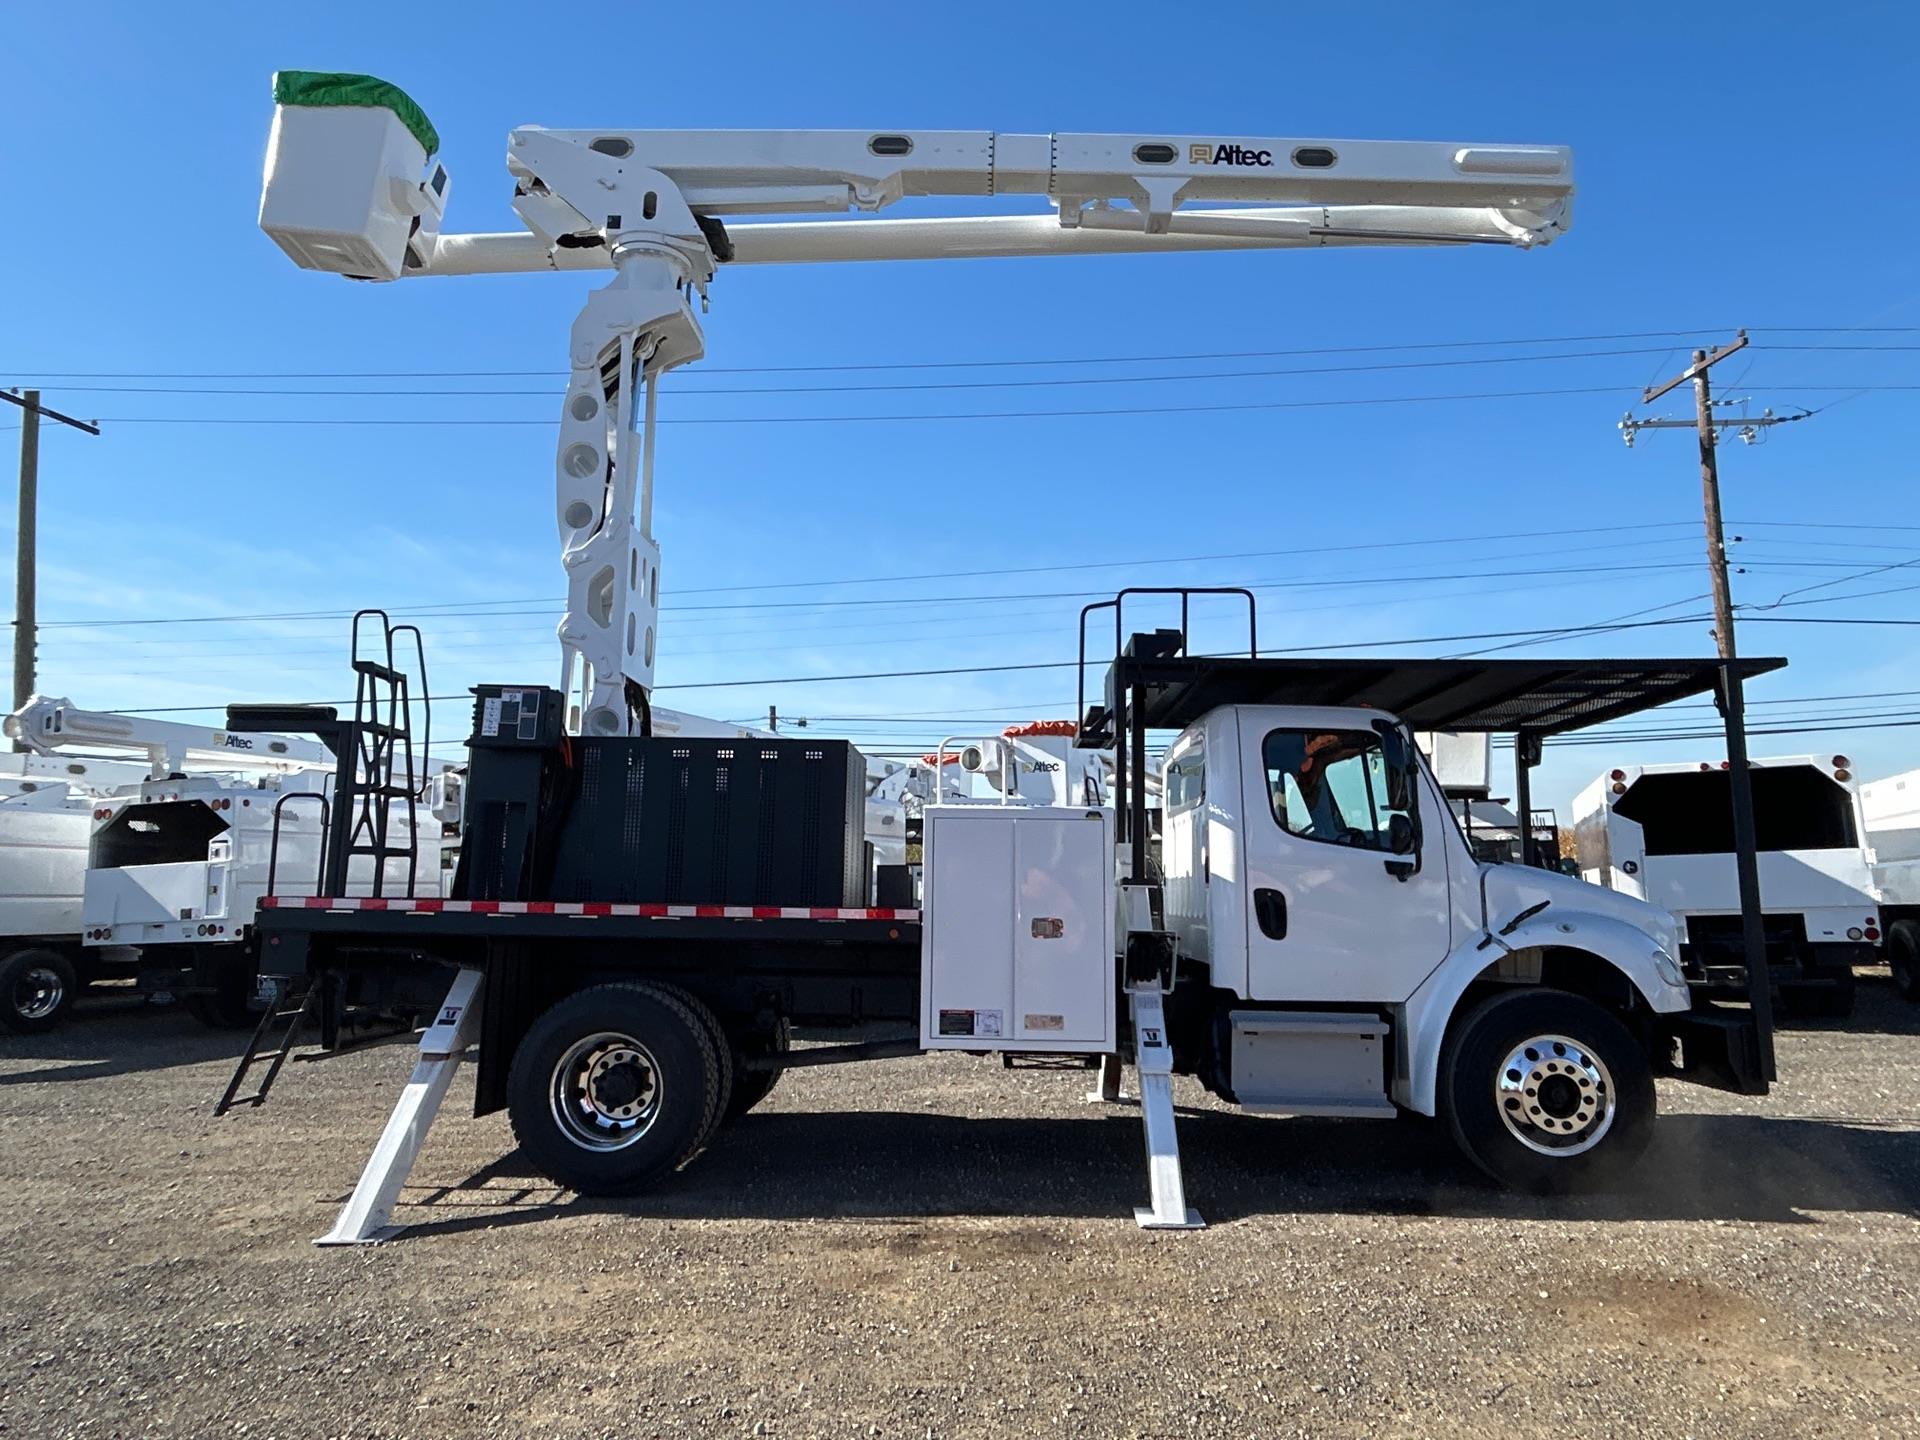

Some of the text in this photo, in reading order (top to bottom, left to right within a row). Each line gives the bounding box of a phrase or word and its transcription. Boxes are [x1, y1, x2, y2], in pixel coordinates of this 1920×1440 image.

[1212, 144, 1272, 166] Altec
[225, 735, 253, 749] Altec
[1032, 761, 1060, 773] Altec
